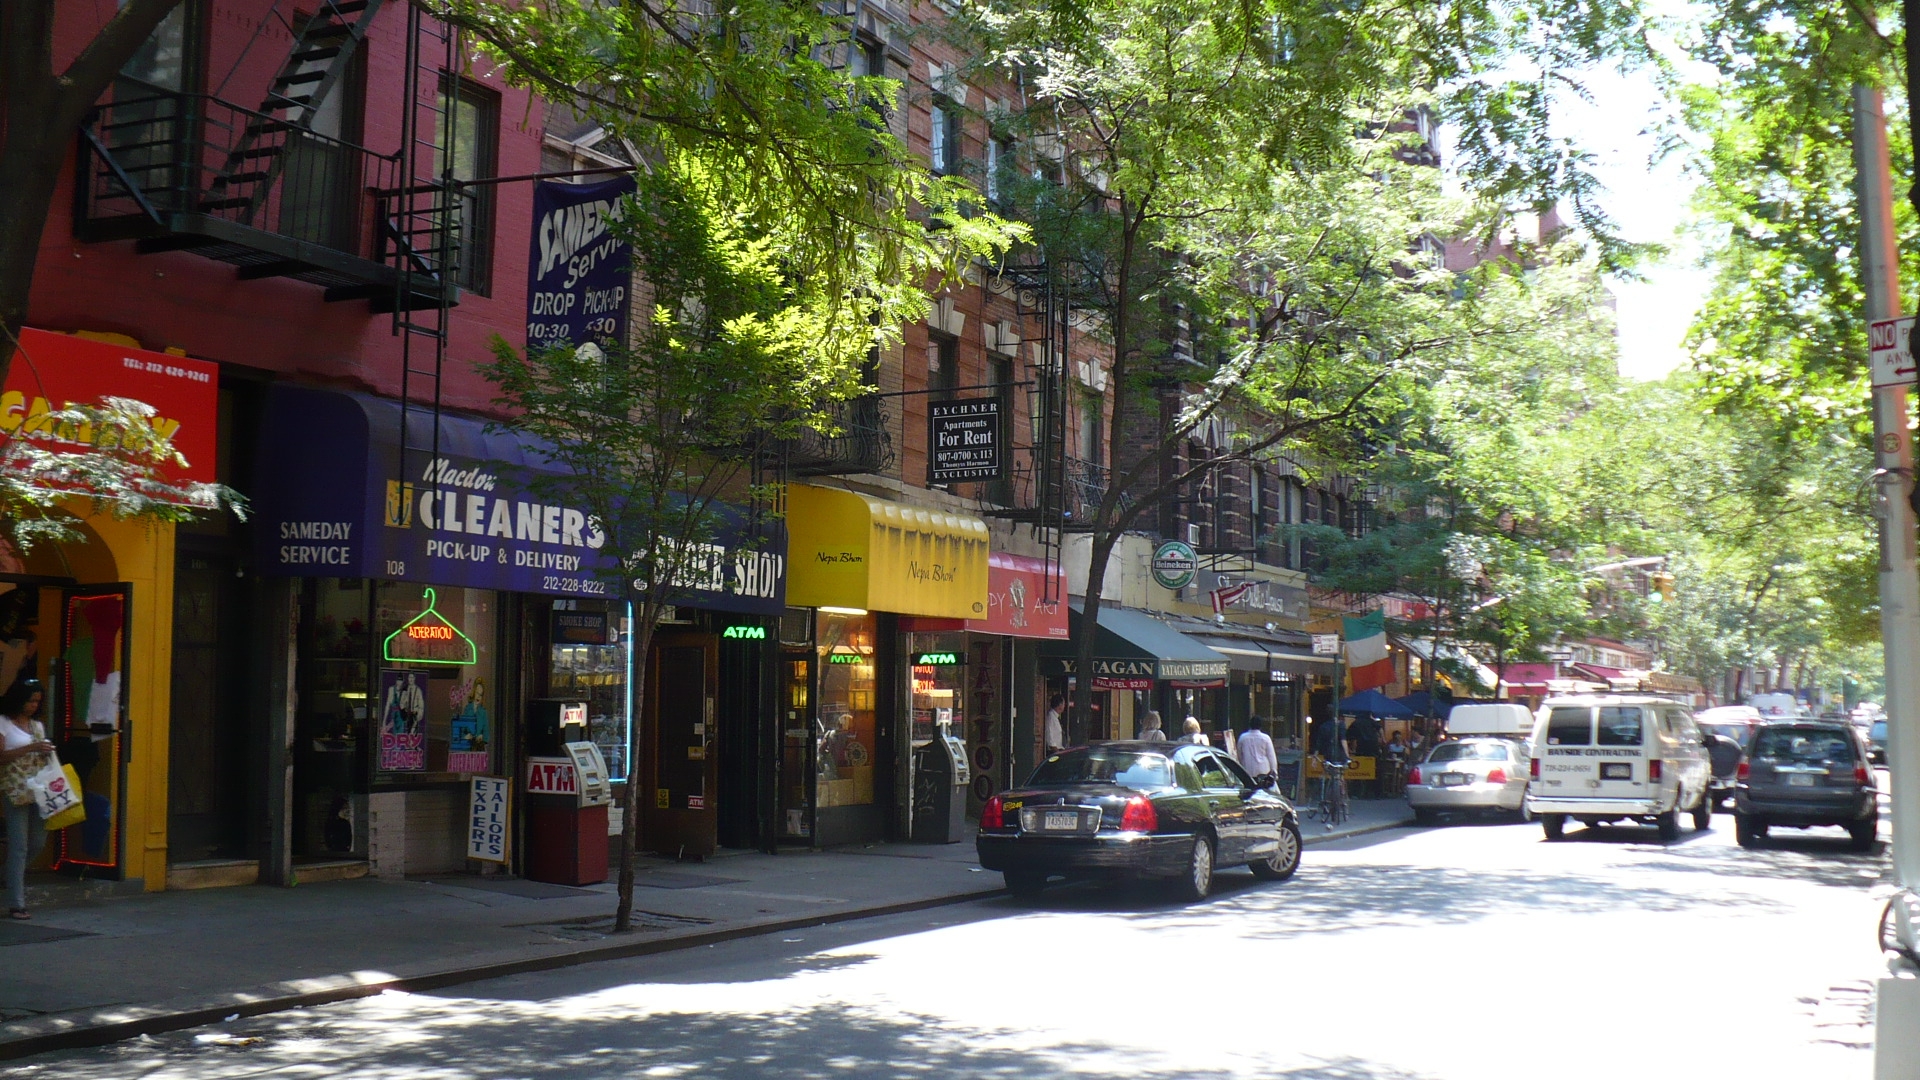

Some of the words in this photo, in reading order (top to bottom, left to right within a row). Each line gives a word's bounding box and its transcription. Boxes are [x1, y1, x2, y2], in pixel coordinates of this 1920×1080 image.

[532, 292, 576, 316] DROP
[582, 286, 625, 316] PICK-UP
[527, 322, 570, 339] 10:30
[1873, 324, 1896, 348] NO
[123, 357, 144, 371] TEL:
[145, 361, 163, 375] 212
[933, 403, 998, 416] EYCHNER
[943, 419, 988, 432] Apartments
[938, 431, 960, 447] For
[963, 430, 993, 445] Rent
[937, 451, 972, 462] 807-0700
[980, 449, 993, 459] 113
[934, 468, 998, 480] EXCLUSIVE
[419, 489, 605, 549] CLEANERS
[280, 522, 352, 540] SAMEDAY
[280, 546, 350, 565] SERVICE
[426, 539, 490, 562] PICK-UP
[498, 548, 507, 564] &
[515, 550, 581, 571] DELIVERY
[814, 552, 838, 564] Nepa
[386, 560, 405, 576] 108
[907, 560, 930, 584] Nepa
[1155, 561, 1192, 569] Heineken
[543, 576, 605, 594] 212-228-8222
[722, 625, 766, 640] ATM
[918, 653, 957, 665] ATM
[1161, 664, 1191, 676] YATAGAN
[1191, 664, 1209, 675] KEBAB
[1130, 680, 1148, 688] $2.00
[563, 710, 583, 720] ATM
[972, 640, 997, 802] TATTOO
[380, 732, 423, 750] DRY
[1547, 748, 1582, 757] BAYSIDE
[528, 764, 576, 792] ATM
[472, 780, 487, 853] EXPERT
[488, 781, 504, 855] TAILORS
